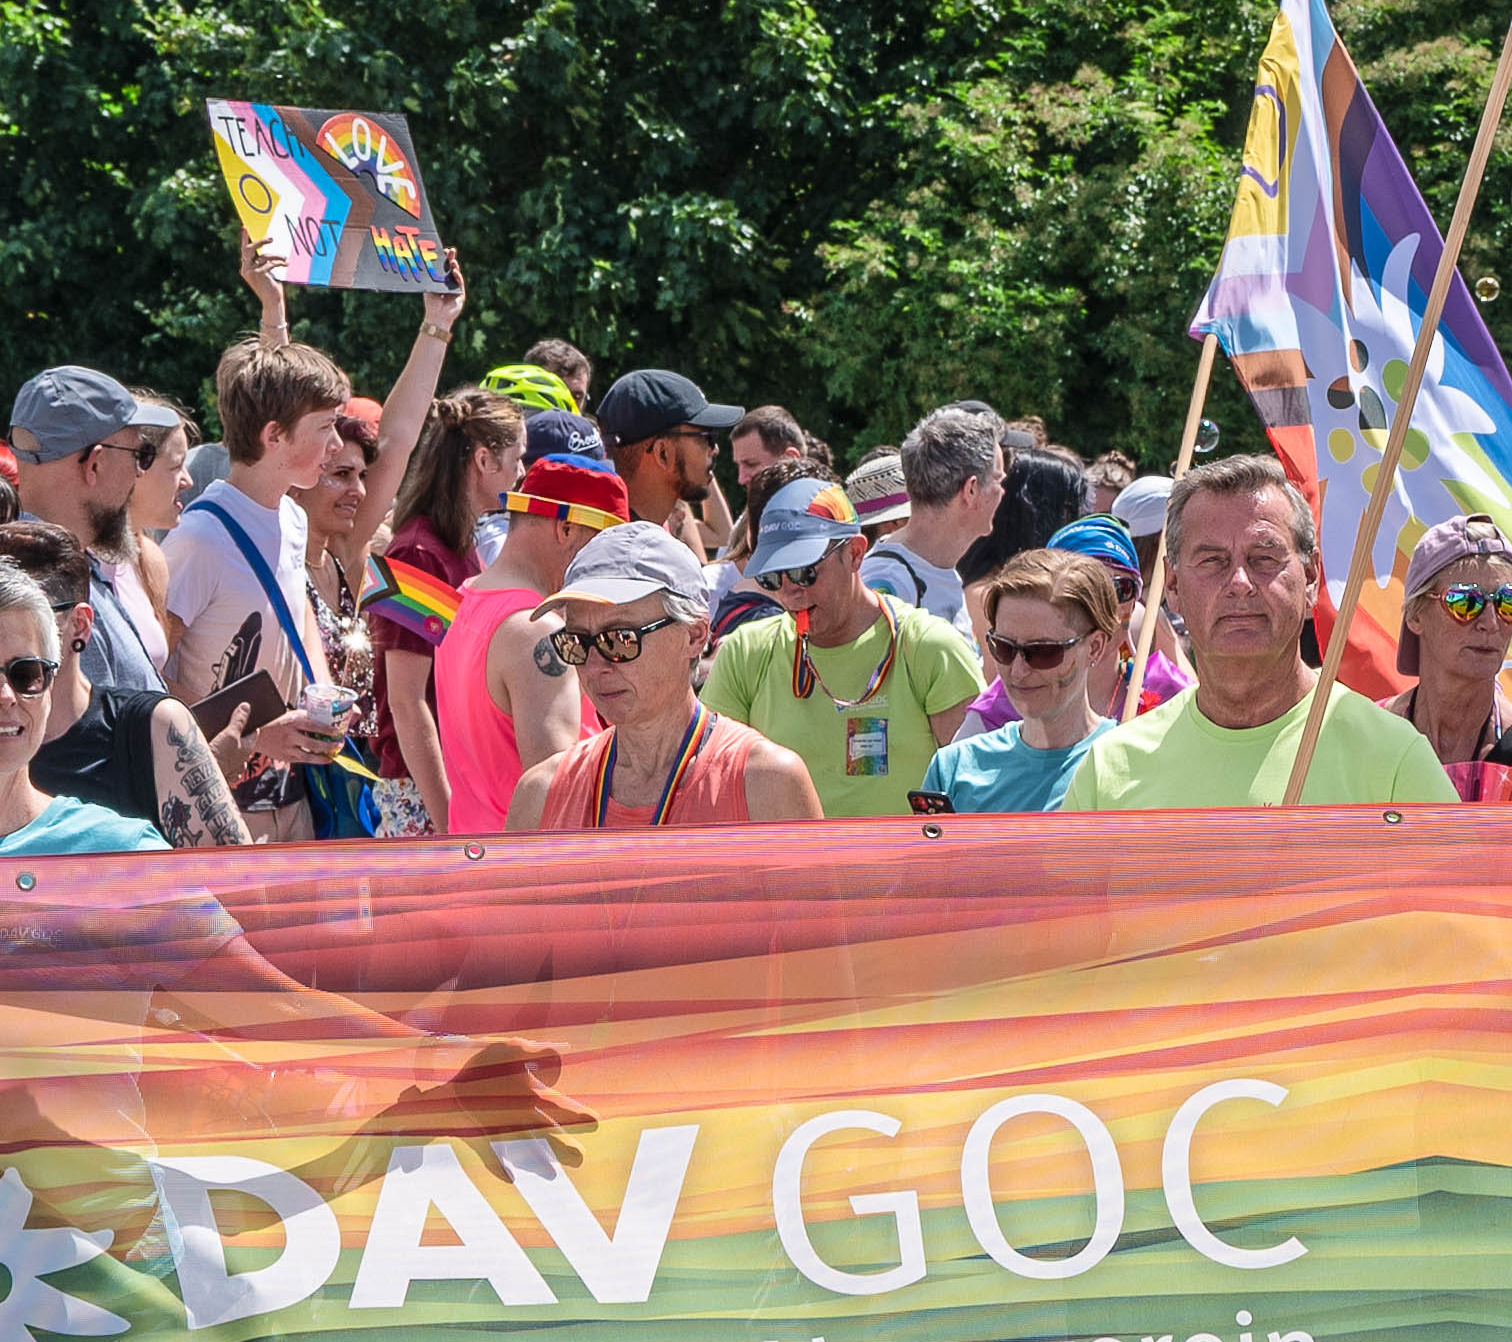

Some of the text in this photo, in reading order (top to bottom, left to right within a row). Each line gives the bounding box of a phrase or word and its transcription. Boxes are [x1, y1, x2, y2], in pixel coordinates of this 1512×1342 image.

[218, 115, 417, 201] TEACH LOVE
[285, 214, 450, 284] NOT HATE
[151, 1077, 1310, 1330] DAV GOC
